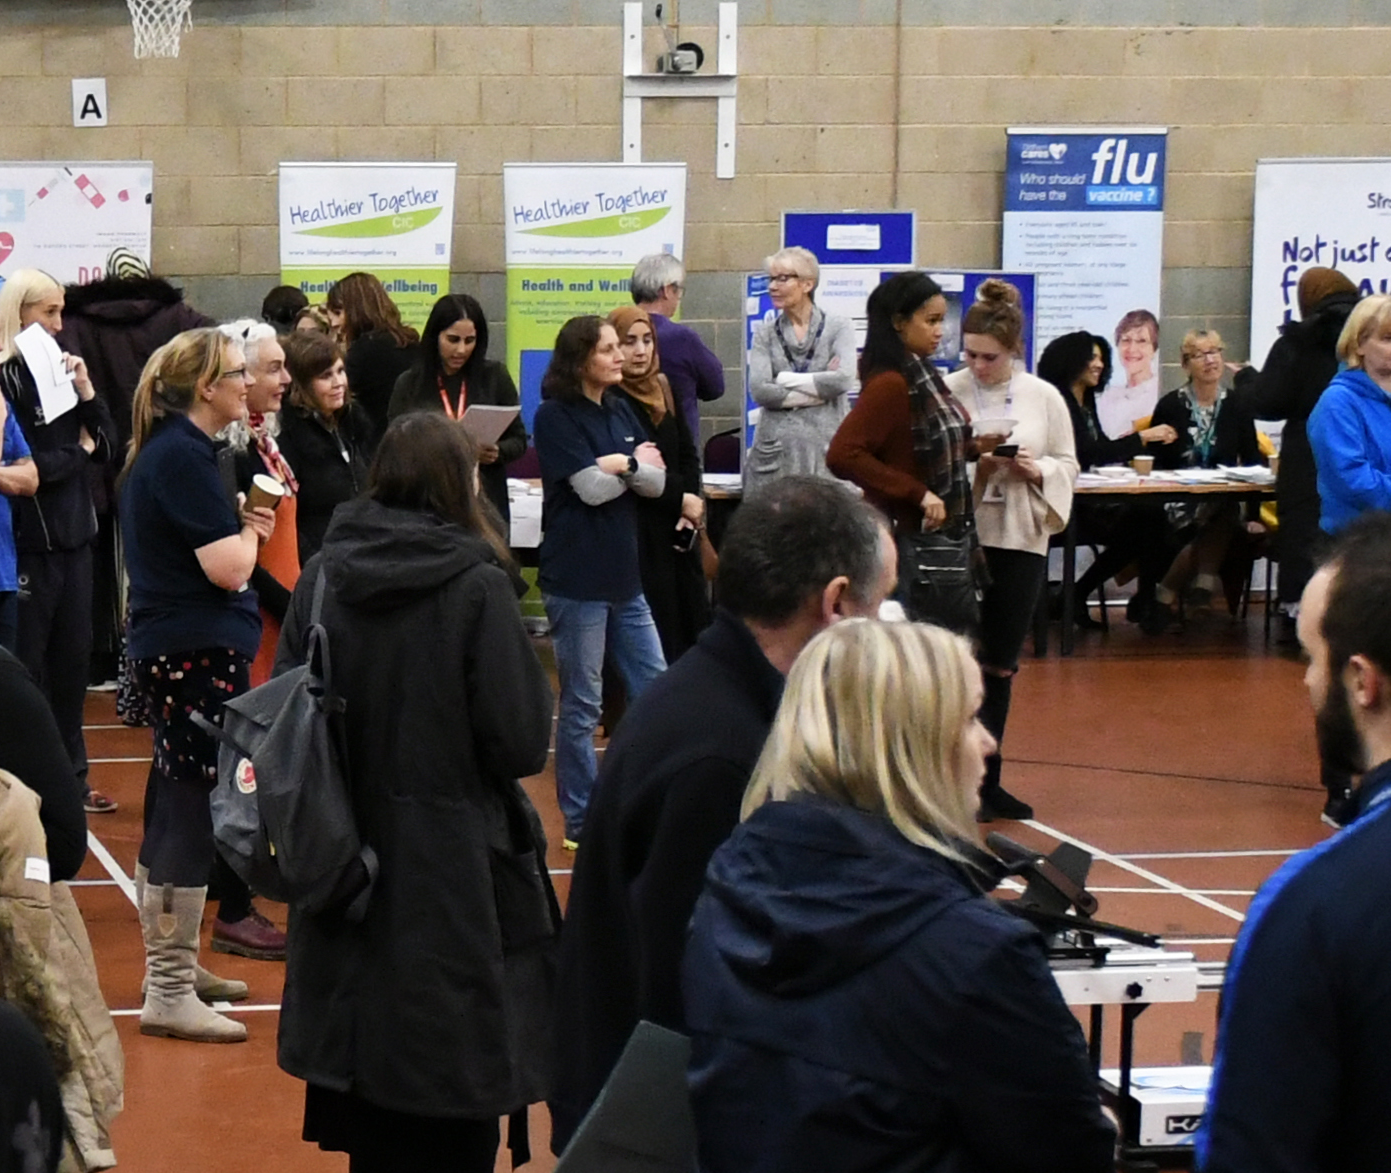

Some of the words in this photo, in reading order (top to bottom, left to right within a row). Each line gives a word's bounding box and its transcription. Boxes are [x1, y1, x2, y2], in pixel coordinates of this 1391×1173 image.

[80, 93, 102, 120] A
[1021, 149, 1049, 159] cares
[1091, 138, 1159, 185] flu
[1020, 172, 1046, 185] Who
[1048, 172, 1087, 185] should
[1019, 189, 1047, 201] have
[1048, 189, 1067, 201] the
[1089, 187, 1143, 202] vaccine
[289, 198, 364, 225] Healthier
[368, 186, 439, 214] Together
[513, 198, 590, 225] Healthier
[595, 186, 668, 214] Together
[392, 216, 415, 229] CIC
[618, 215, 642, 229] CIC
[1282, 234, 1327, 264] Not
[1331, 236, 1380, 269] just
[521, 278, 564, 292] Health
[569, 279, 594, 292] and
